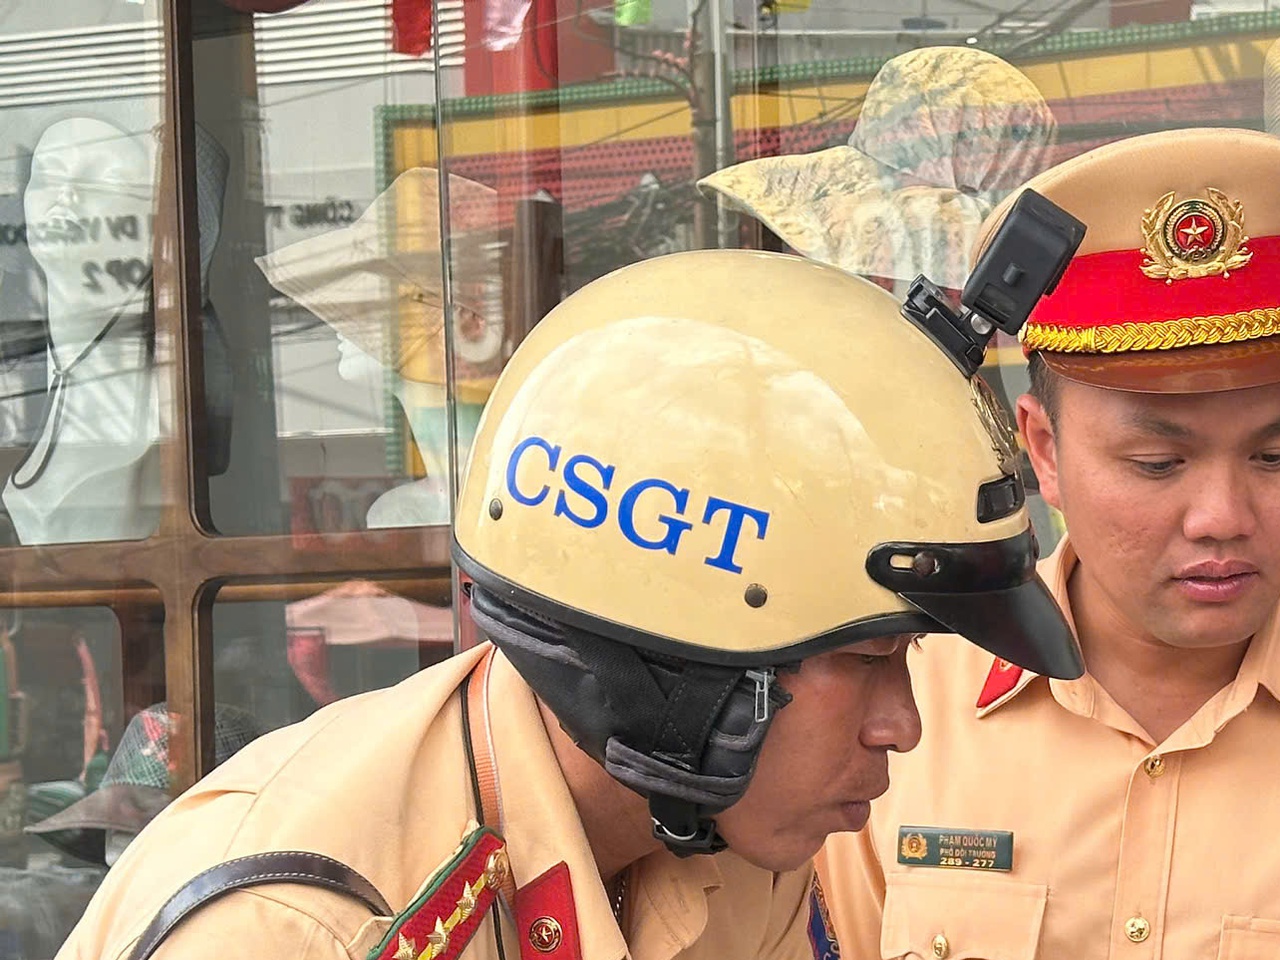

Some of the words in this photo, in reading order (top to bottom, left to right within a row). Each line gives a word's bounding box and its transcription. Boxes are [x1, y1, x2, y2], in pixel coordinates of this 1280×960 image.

[506, 437, 770, 574] CSGT
[940, 857, 962, 866] 289
[972, 859, 995, 868] 277
